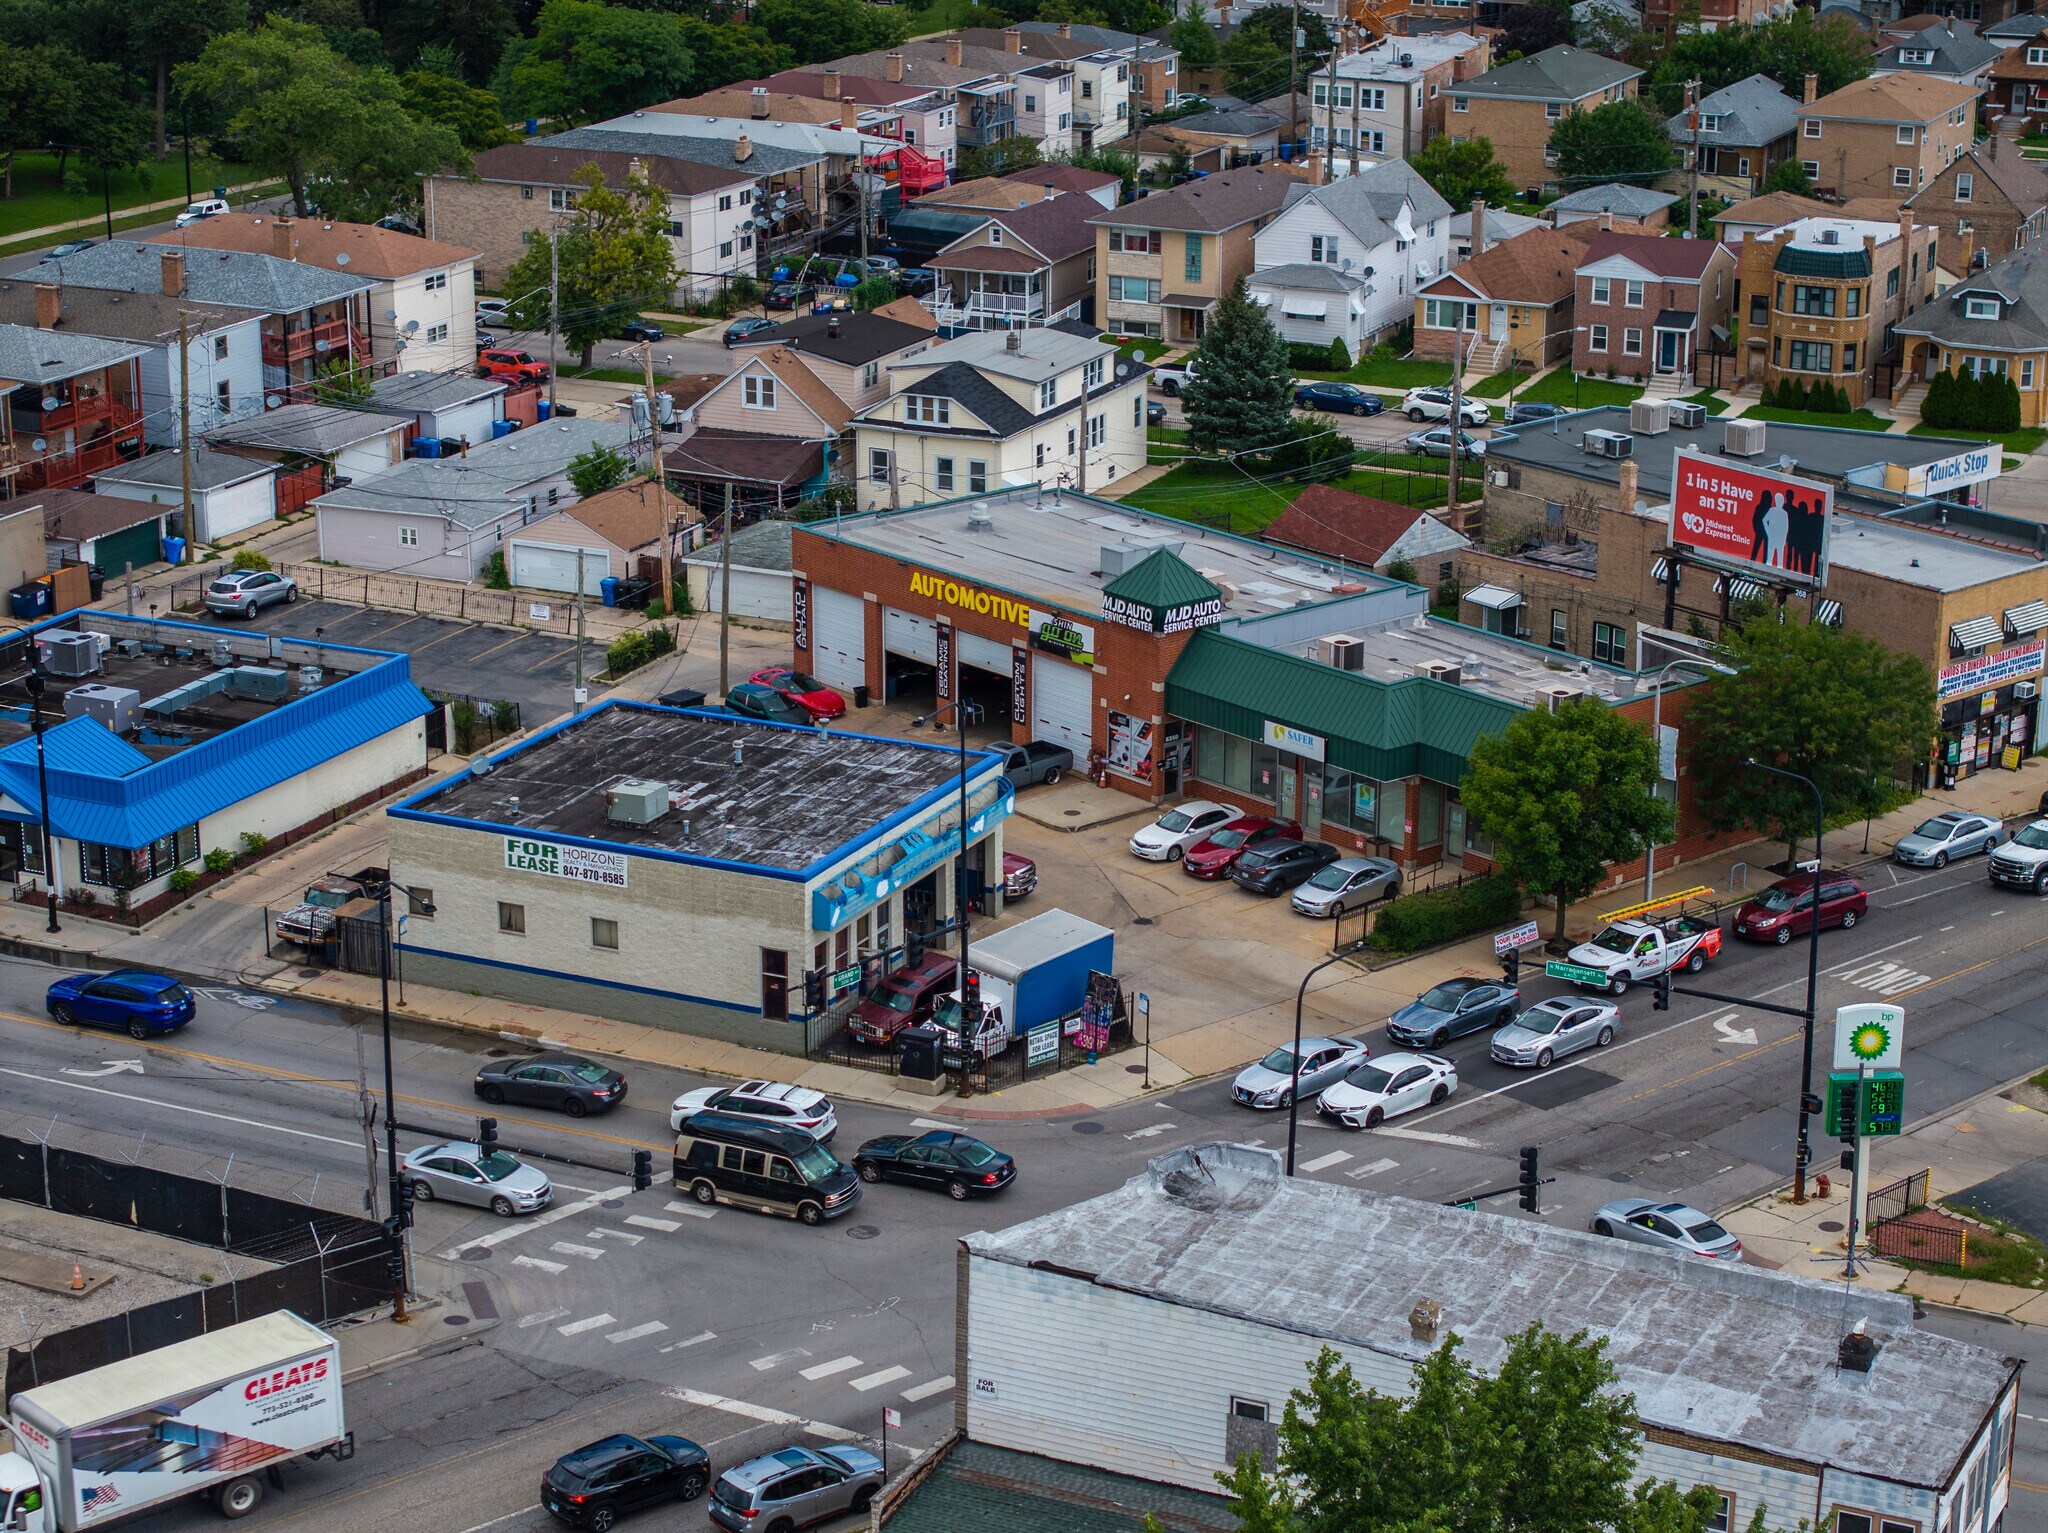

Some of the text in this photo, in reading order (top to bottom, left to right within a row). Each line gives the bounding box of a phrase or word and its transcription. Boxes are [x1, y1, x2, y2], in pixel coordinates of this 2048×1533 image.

[1931, 454, 1988, 482] Quick Stop
[1686, 472, 1753, 501] 1 in 5 Have
[1699, 495, 1738, 515] an STI
[1705, 526, 1750, 545] Express Clinic
[1706, 519, 1734, 533] Midwest
[910, 572, 1029, 628] AUTOMOTIVE
[1795, 589, 1807, 598] 268
[1102, 596, 1152, 622] MJD AUTO
[1164, 600, 1220, 623] MJD AUTO
[1052, 618, 1073, 630] SHIN
[1101, 609, 1153, 633] SERVICE CENTER
[1163, 614, 1221, 634] SERVICE CENTER
[1040, 623, 1083, 645] go on
[1941, 664, 1959, 679] ENVIOS
[1960, 662, 1967, 673] DE
[1968, 658, 1986, 672] DINERO
[1987, 656, 1990, 666] A
[1992, 652, 2004, 664] TODA
[1943, 652, 2040, 685] PAQUETERIA RECARGAS TELEFONICAS
[1962, 674, 1984, 687] ORDERS
[1989, 669, 2007, 679] PAGOS
[2015, 658, 2041, 671] FACTURAS
[1288, 730, 1314, 746] SAFER
[508, 839, 558, 859] FOR
[563, 848, 615, 865] HORIZON
[508, 854, 559, 874] LEASE
[588, 862, 624, 873] MANAGEMENT
[904, 844, 958, 881] 773-622-4142
[563, 865, 624, 885] 847-870-8585
[1496, 936, 1510, 945] YOUR
[1496, 943, 1512, 952] Bench
[1555, 964, 1595, 977] Narragansett
[1642, 959, 1660, 968] ProTech
[838, 971, 854, 981] GRAND
[1829, 960, 1932, 995] ONLY
[1881, 1012, 1894, 1022] bp
[1030, 1031, 1058, 1046] RETAIL SPACE
[1032, 1041, 1054, 1053] FOR LEASE
[245, 1358, 328, 1400] CLEATS
[299, 1378, 327, 1389] COMPANY
[976, 1384, 995, 1393] SALE
[251, 1398, 326, 1426] www.cleatsmfg.com
[262, 1393, 314, 1414] 773-521-0300
